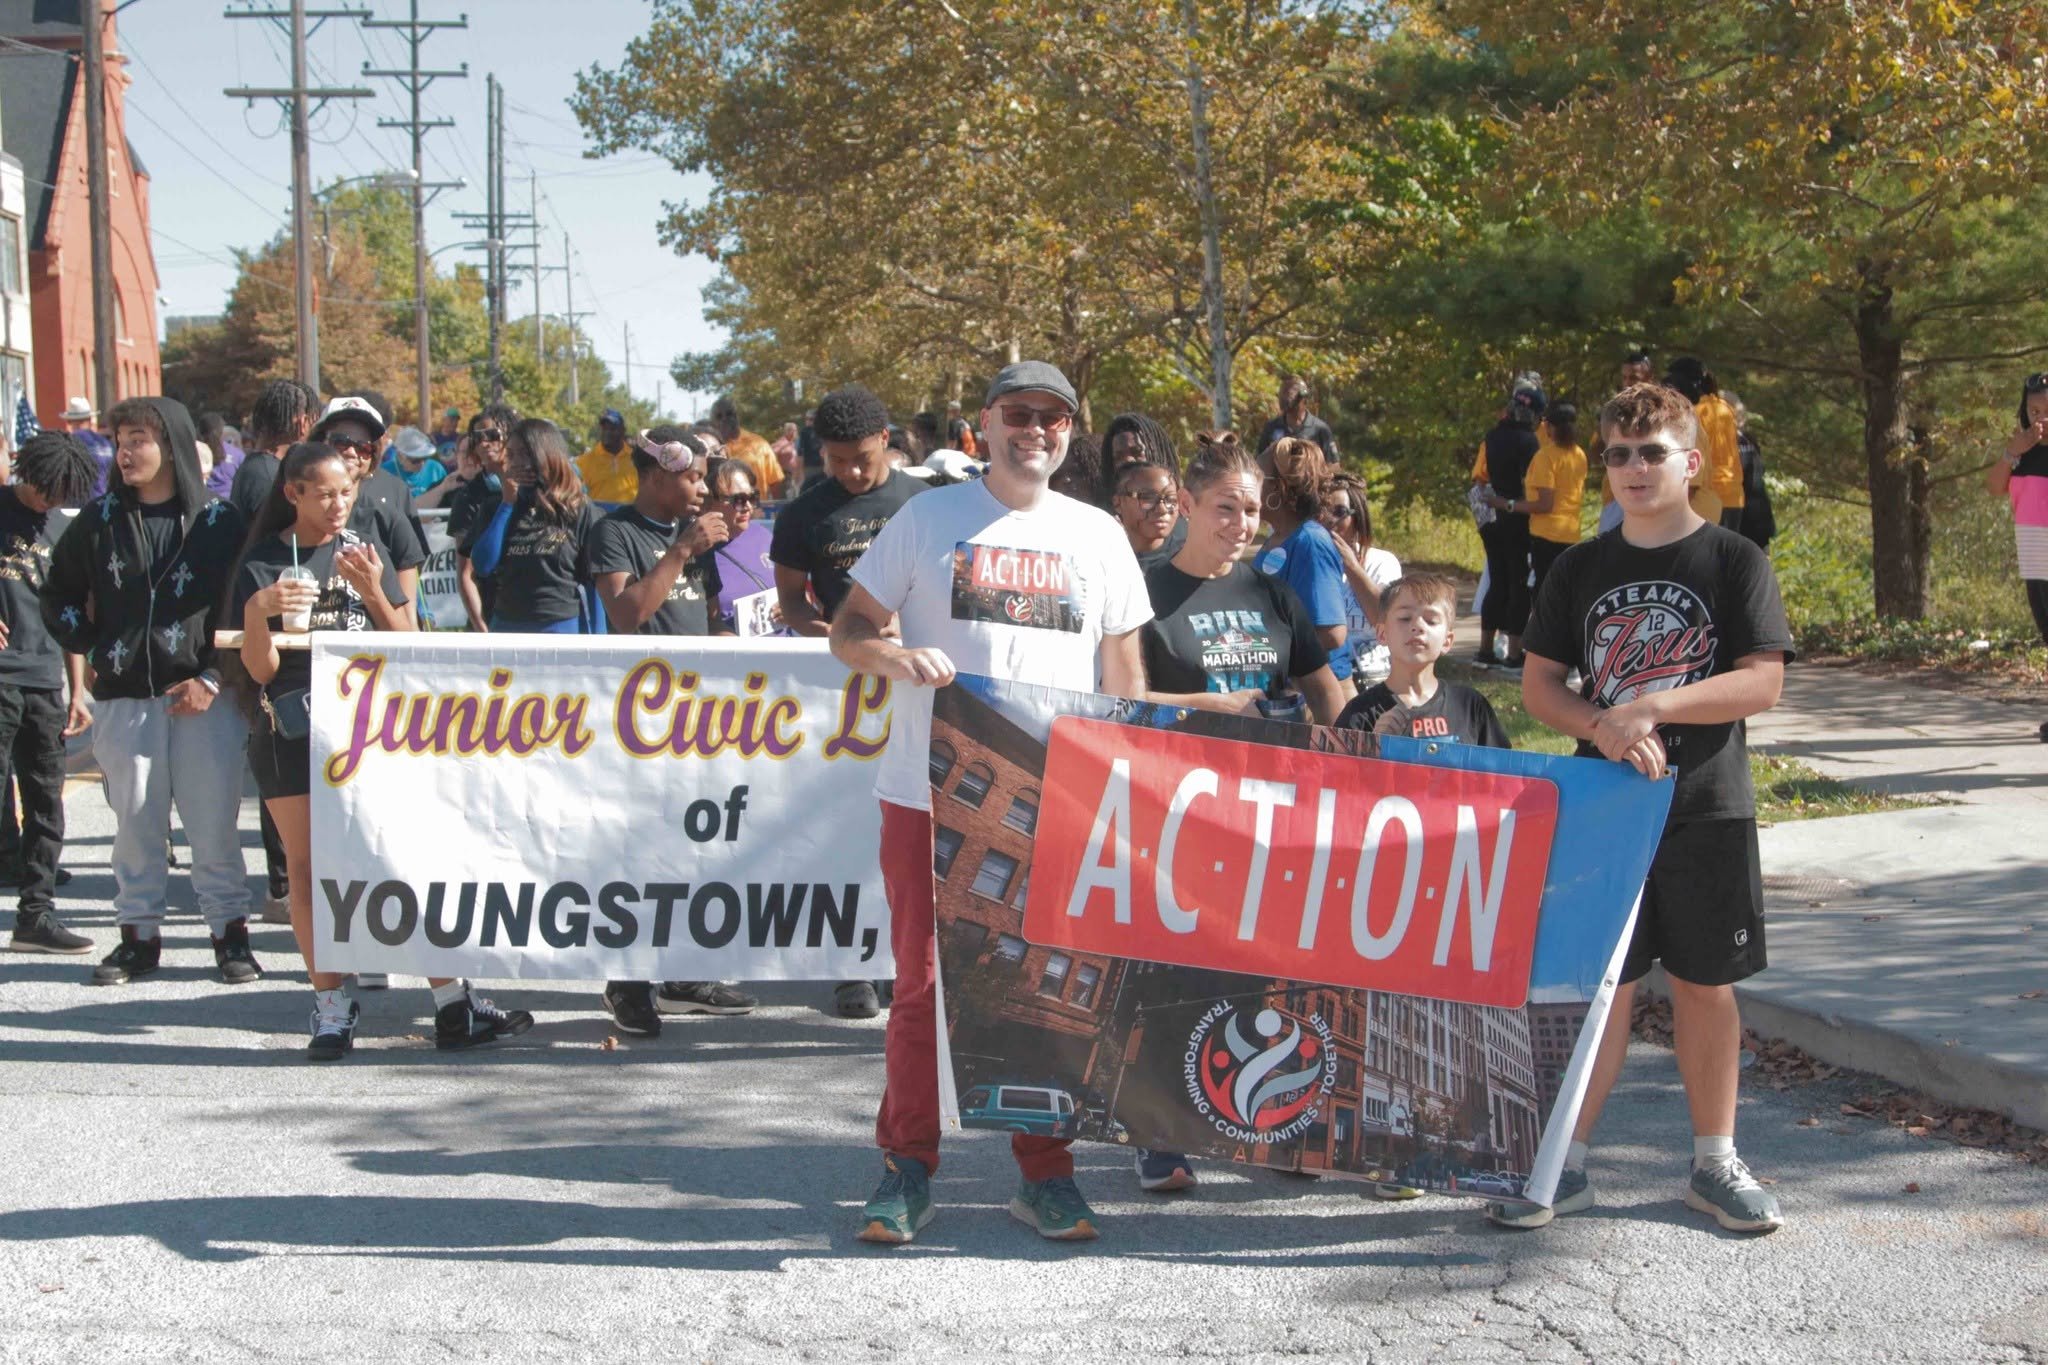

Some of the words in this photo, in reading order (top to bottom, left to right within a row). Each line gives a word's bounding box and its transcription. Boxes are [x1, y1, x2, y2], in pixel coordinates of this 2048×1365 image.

[424, 549, 456, 572] NER
[420, 577, 456, 595] CIATI
[1607, 585, 1682, 609] TEAM
[1188, 610, 1269, 638] RUN
[1648, 613, 1665, 631] 12
[1202, 652, 1278, 667] MARATHON
[1590, 609, 1717, 702] Jesus
[323, 652, 595, 788] Junior
[612, 657, 806, 760] Civic
[823, 671, 892, 761] L
[1412, 717, 1449, 738] PRO
[683, 785, 749, 843] of
[319, 878, 880, 963] YOUNGSTOWN,
[1184, 999, 1234, 1115] TRANSFORMING
[1215, 1105, 1319, 1144] COMMUNITIES
[1309, 1011, 1337, 1096] TOGETHER
